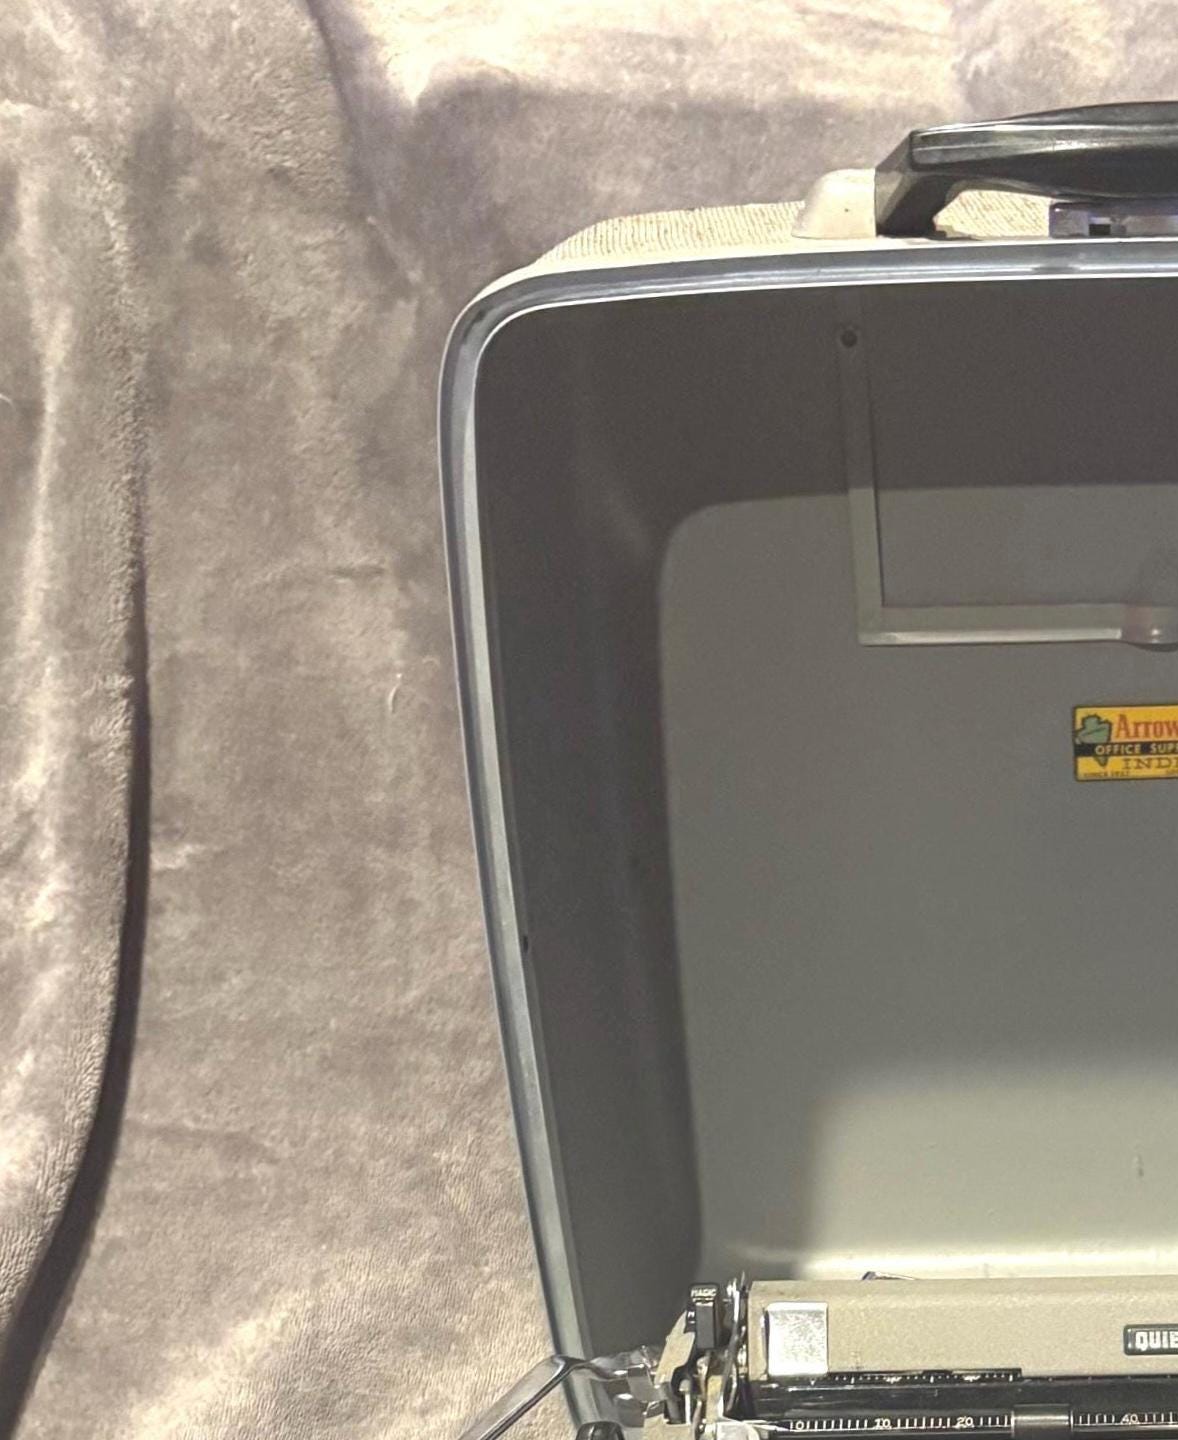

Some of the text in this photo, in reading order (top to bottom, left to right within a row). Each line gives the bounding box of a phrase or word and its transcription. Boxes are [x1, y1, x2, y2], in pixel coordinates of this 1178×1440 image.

[1095, 744, 1141, 755] OFFICE
[874, 1417, 891, 1429] 10
[957, 1416, 974, 1428] 20
[1122, 1413, 1139, 1424] 40
